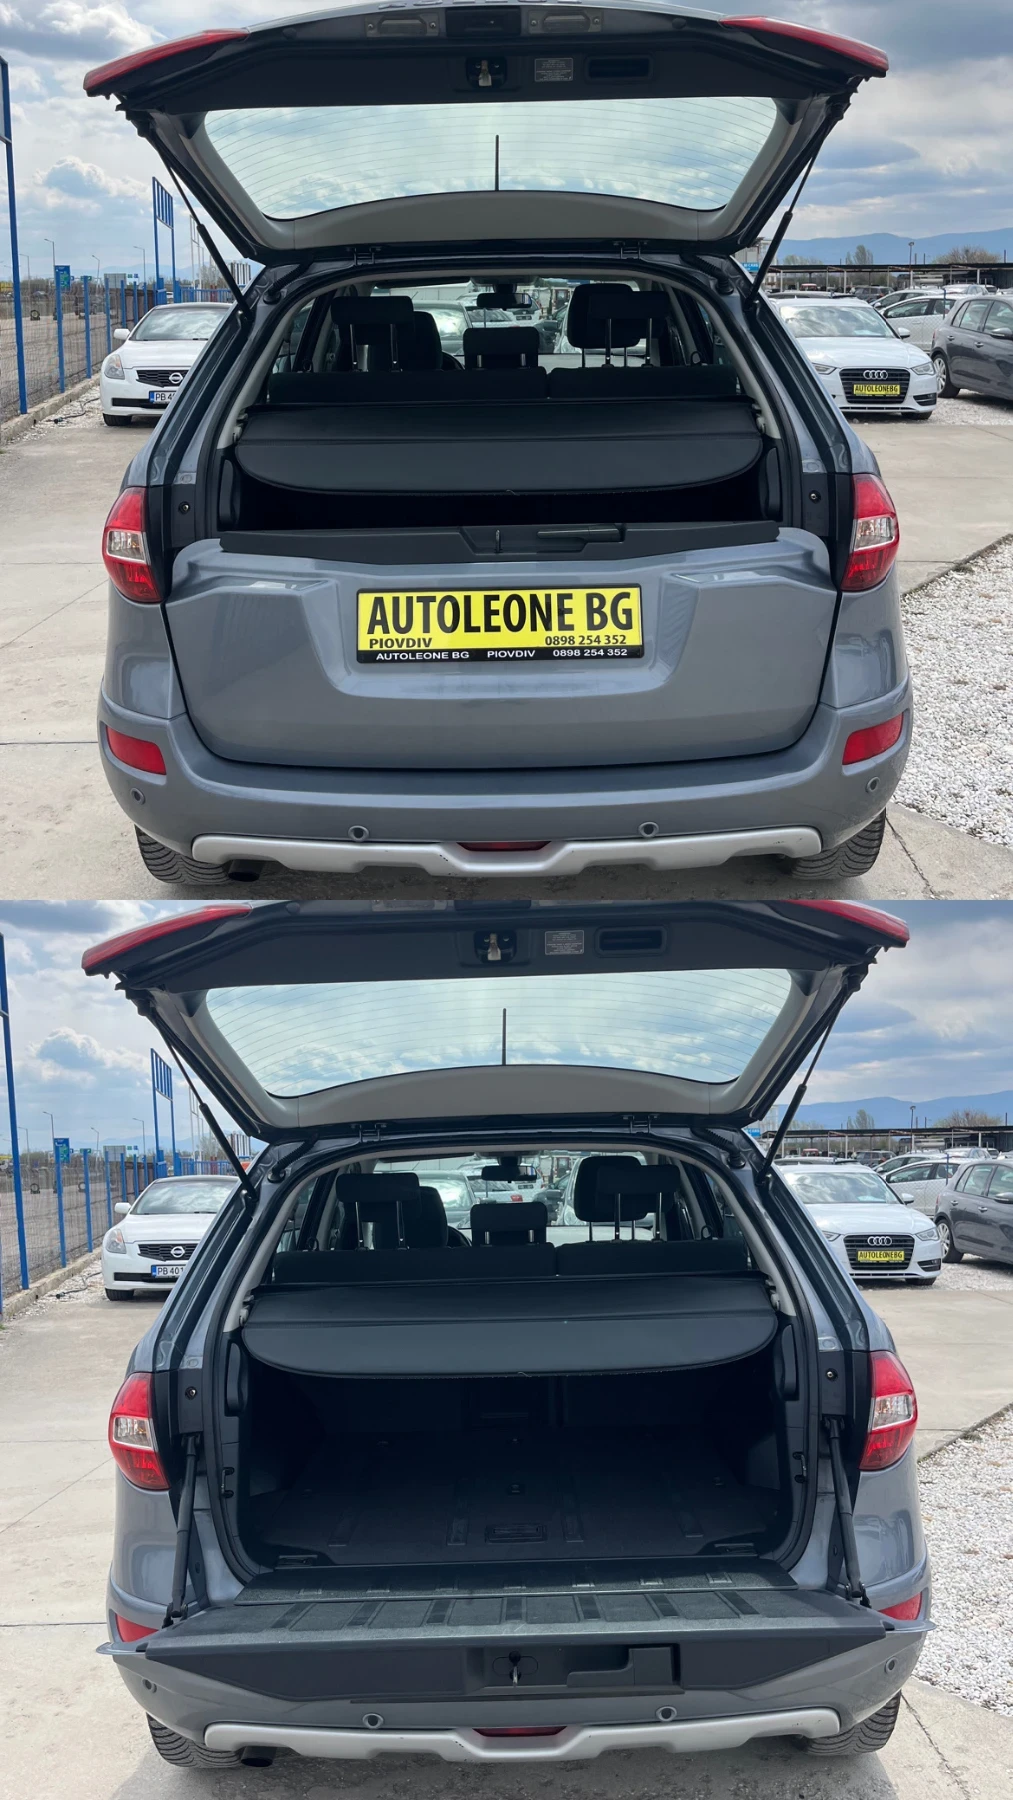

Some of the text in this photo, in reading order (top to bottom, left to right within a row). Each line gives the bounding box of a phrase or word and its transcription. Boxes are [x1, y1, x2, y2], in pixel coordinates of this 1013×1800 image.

[367, 591, 633, 635] AUTOLEONE BG
[369, 634, 627, 649] PIOVDIV 0898 254 352
[376, 648, 628, 660] AUTOLEONE BG PIOVDIV 0898 254 352
[158, 1267, 168, 1275] PB
